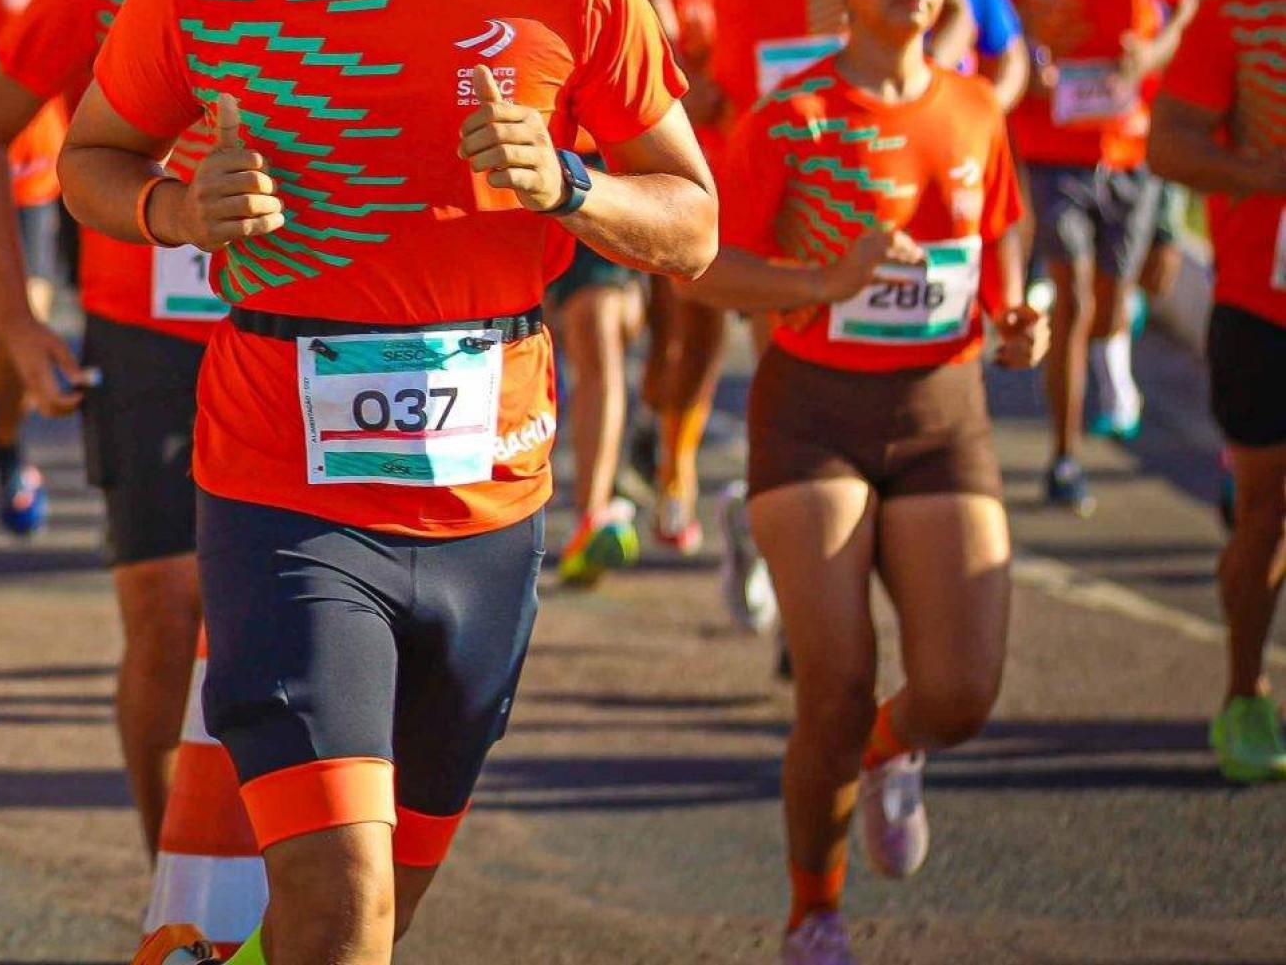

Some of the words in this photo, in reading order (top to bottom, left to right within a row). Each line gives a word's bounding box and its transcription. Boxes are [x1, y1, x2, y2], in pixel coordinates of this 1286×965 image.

[869, 282, 945, 310] 286
[383, 350, 425, 363] SESC
[352, 387, 459, 433] 037
